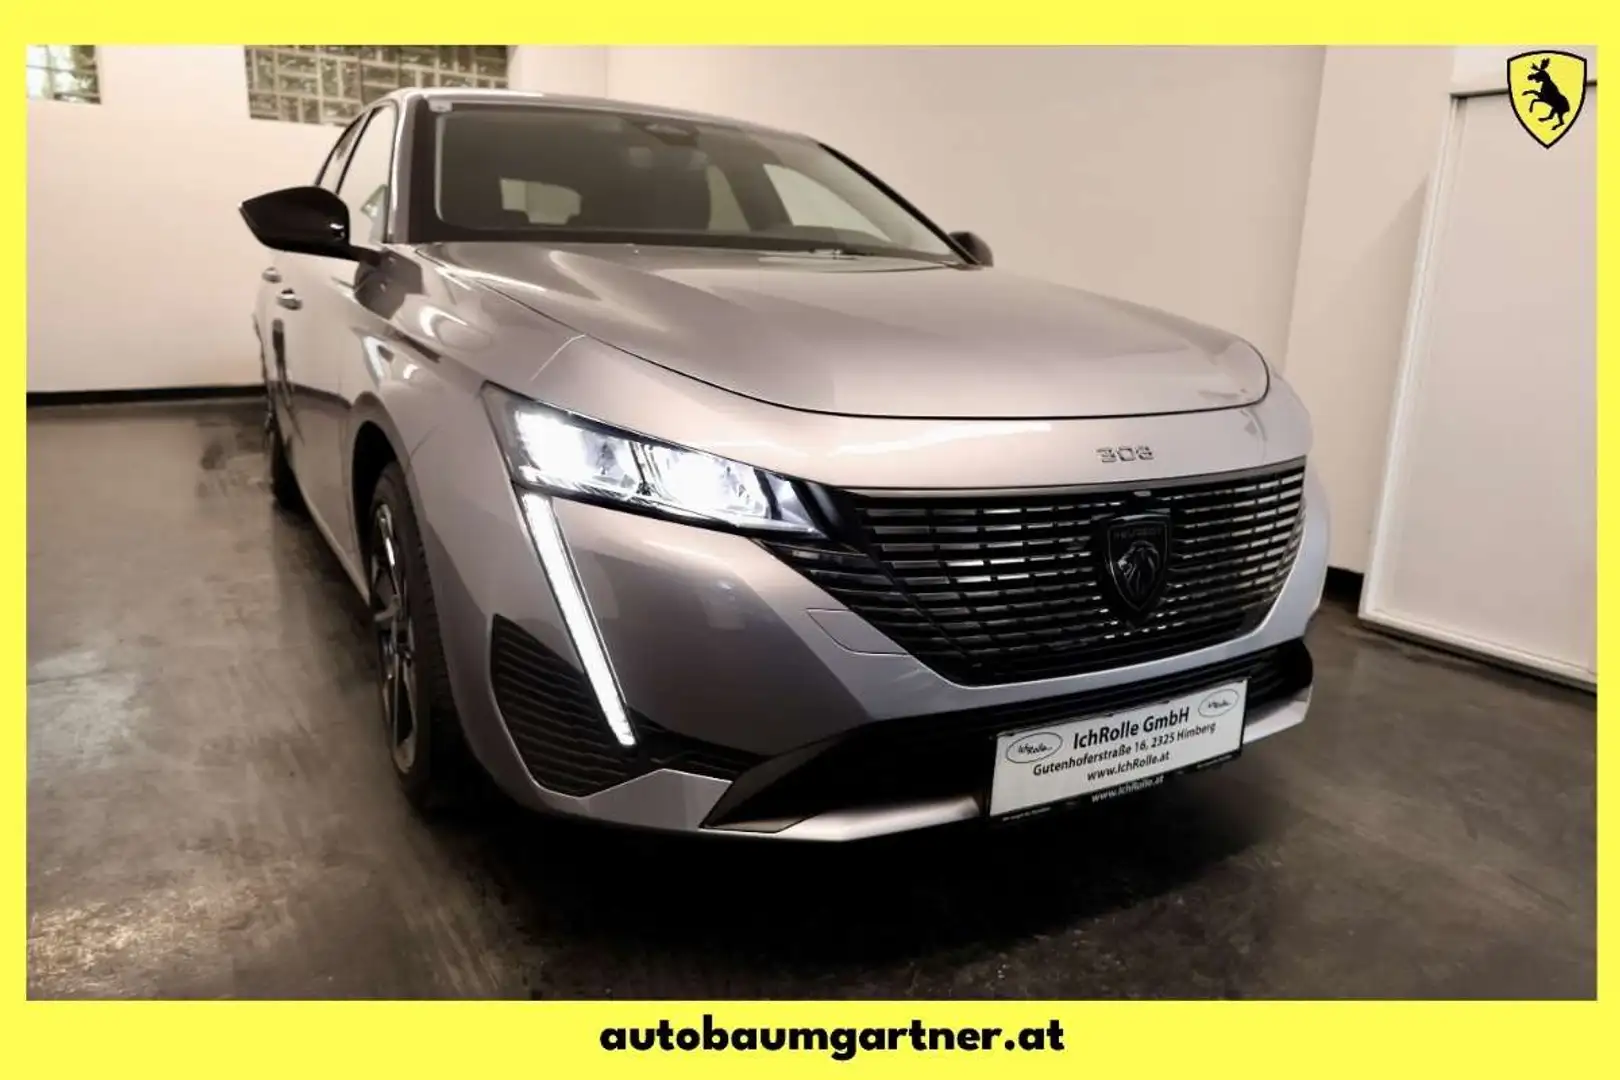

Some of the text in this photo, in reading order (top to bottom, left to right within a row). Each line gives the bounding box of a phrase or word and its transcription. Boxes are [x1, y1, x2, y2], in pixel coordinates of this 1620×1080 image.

[1096, 446, 1153, 463] 308
[1073, 720, 1139, 750] IchRolle
[1143, 706, 1190, 733] GmbH
[1033, 744, 1132, 776] Gutenhoferstraße
[1151, 732, 1175, 748] 2325
[1177, 722, 1216, 741] Himberg
[1087, 751, 1170, 781] www.IchRolle.at
